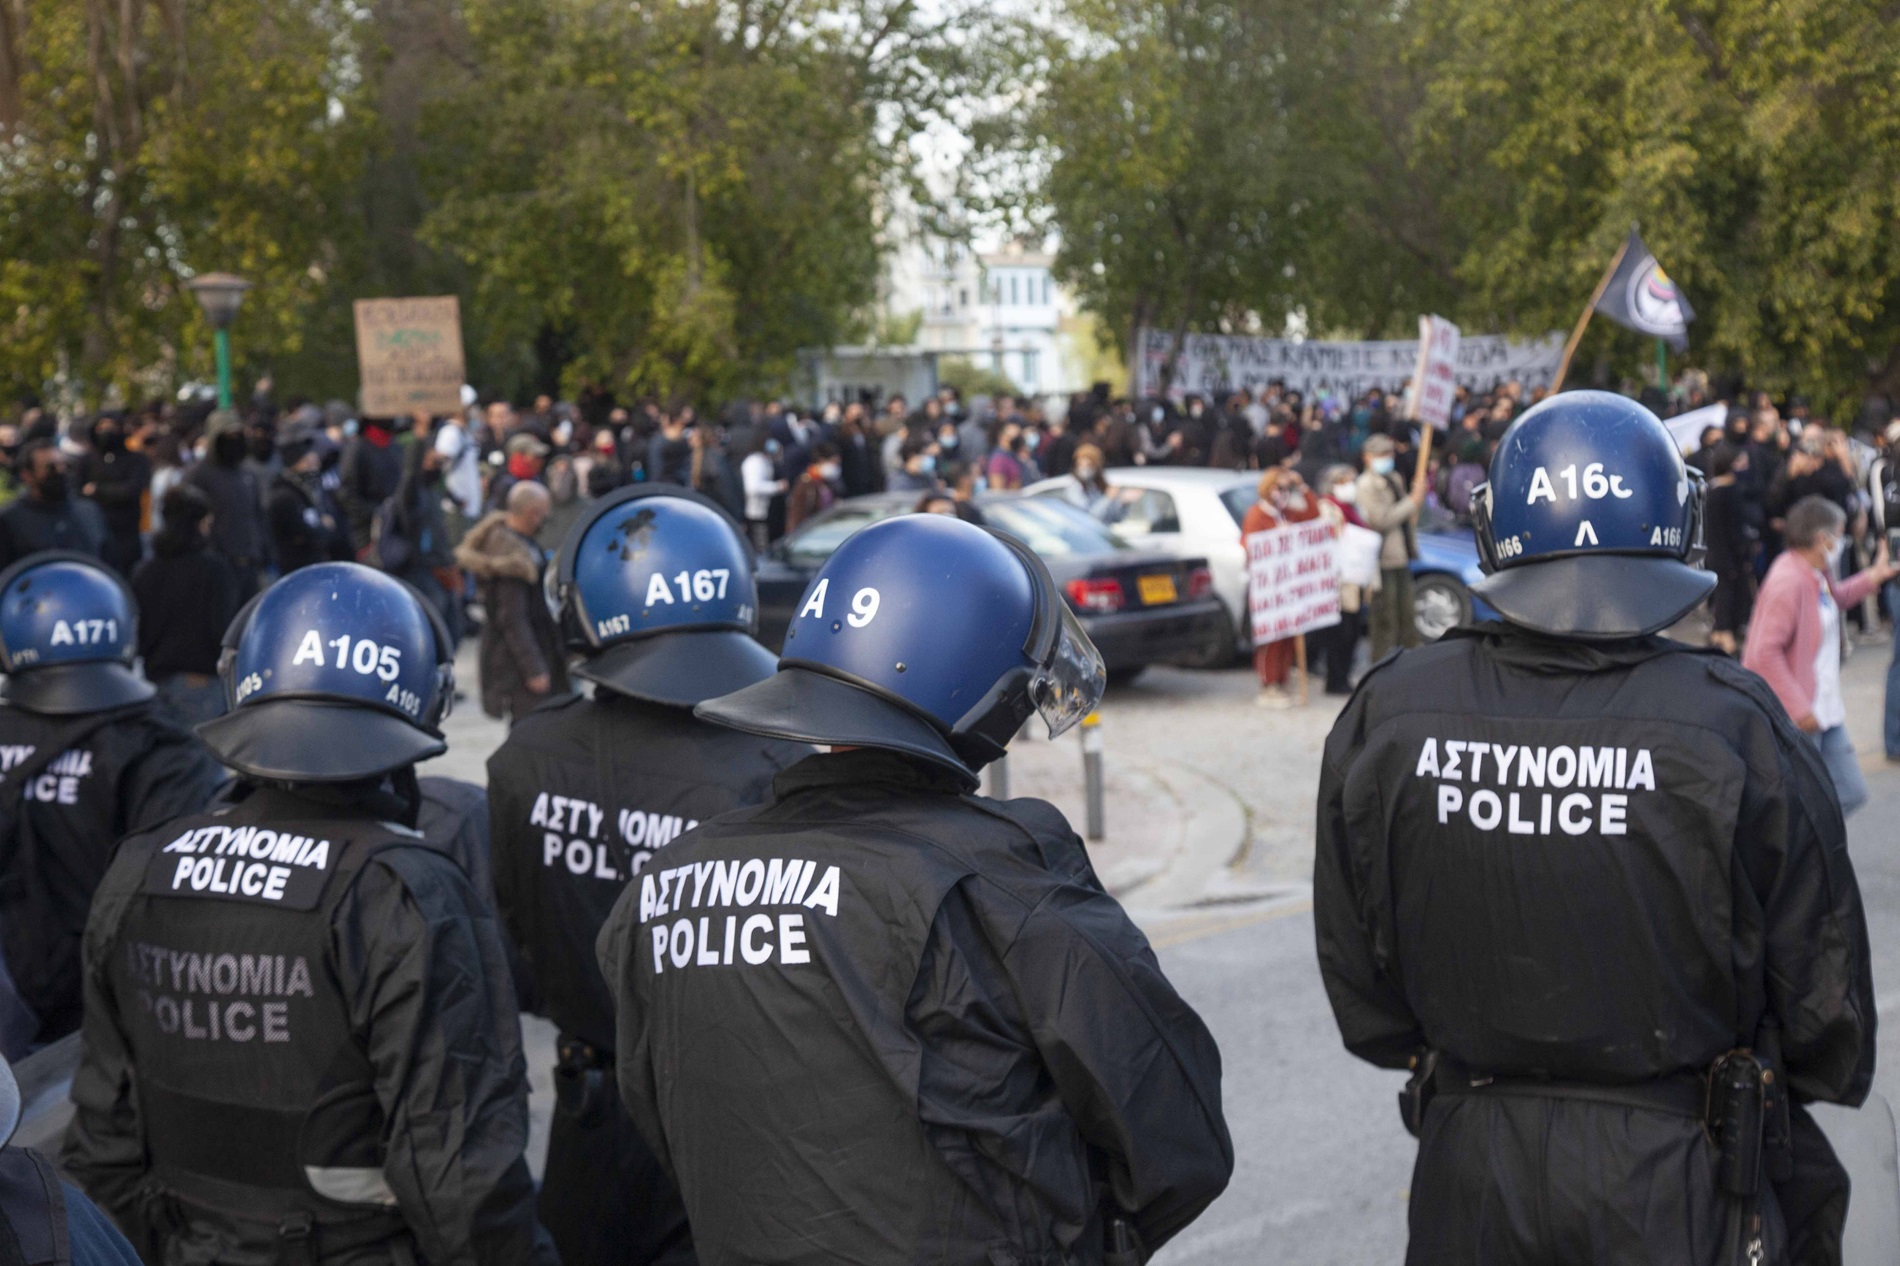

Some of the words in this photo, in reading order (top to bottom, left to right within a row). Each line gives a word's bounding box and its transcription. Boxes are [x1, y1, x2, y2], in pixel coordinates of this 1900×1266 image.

[1649, 526, 1682, 547] A166
[645, 568, 730, 607] A167
[50, 619, 118, 647] A171
[292, 629, 402, 682] A105
[386, 683, 422, 717] A105
[1415, 737, 1656, 791] ΑΣΤΥΝΟΜΙΑ
[1437, 784, 1629, 835] POLICE
[171, 856, 292, 900] POLICE
[639, 857, 841, 924] ΑΣΤΥΝΟΜΙΑ
[651, 913, 811, 974] POLICE
